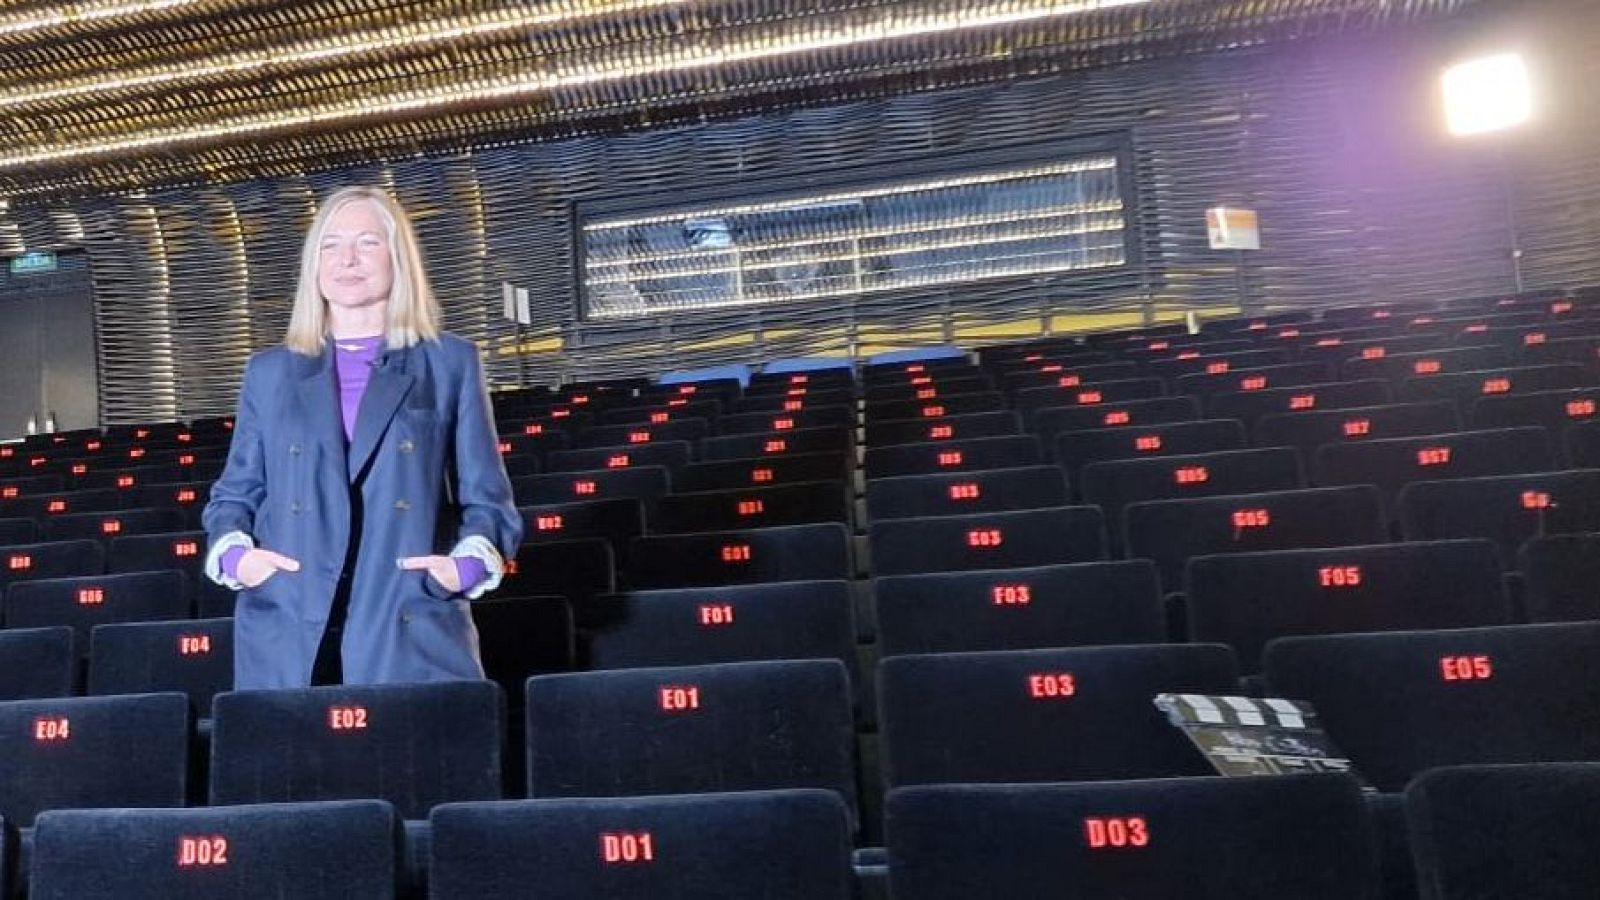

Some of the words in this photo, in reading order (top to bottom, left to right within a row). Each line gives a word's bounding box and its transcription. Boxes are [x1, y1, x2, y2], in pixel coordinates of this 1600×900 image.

[968, 529, 1002, 547] G03
[1319, 566, 1361, 587] F05
[992, 585, 1031, 604] F03
[701, 606, 733, 625] F01
[181, 635, 211, 654] F04
[1440, 656, 1492, 681] E05
[1029, 674, 1075, 698] E03
[660, 687, 699, 710] E01
[331, 707, 367, 729] E02
[36, 719, 70, 741] E04
[1086, 816, 1149, 848] D03
[180, 838, 228, 865] D02
[603, 834, 653, 861] D01
